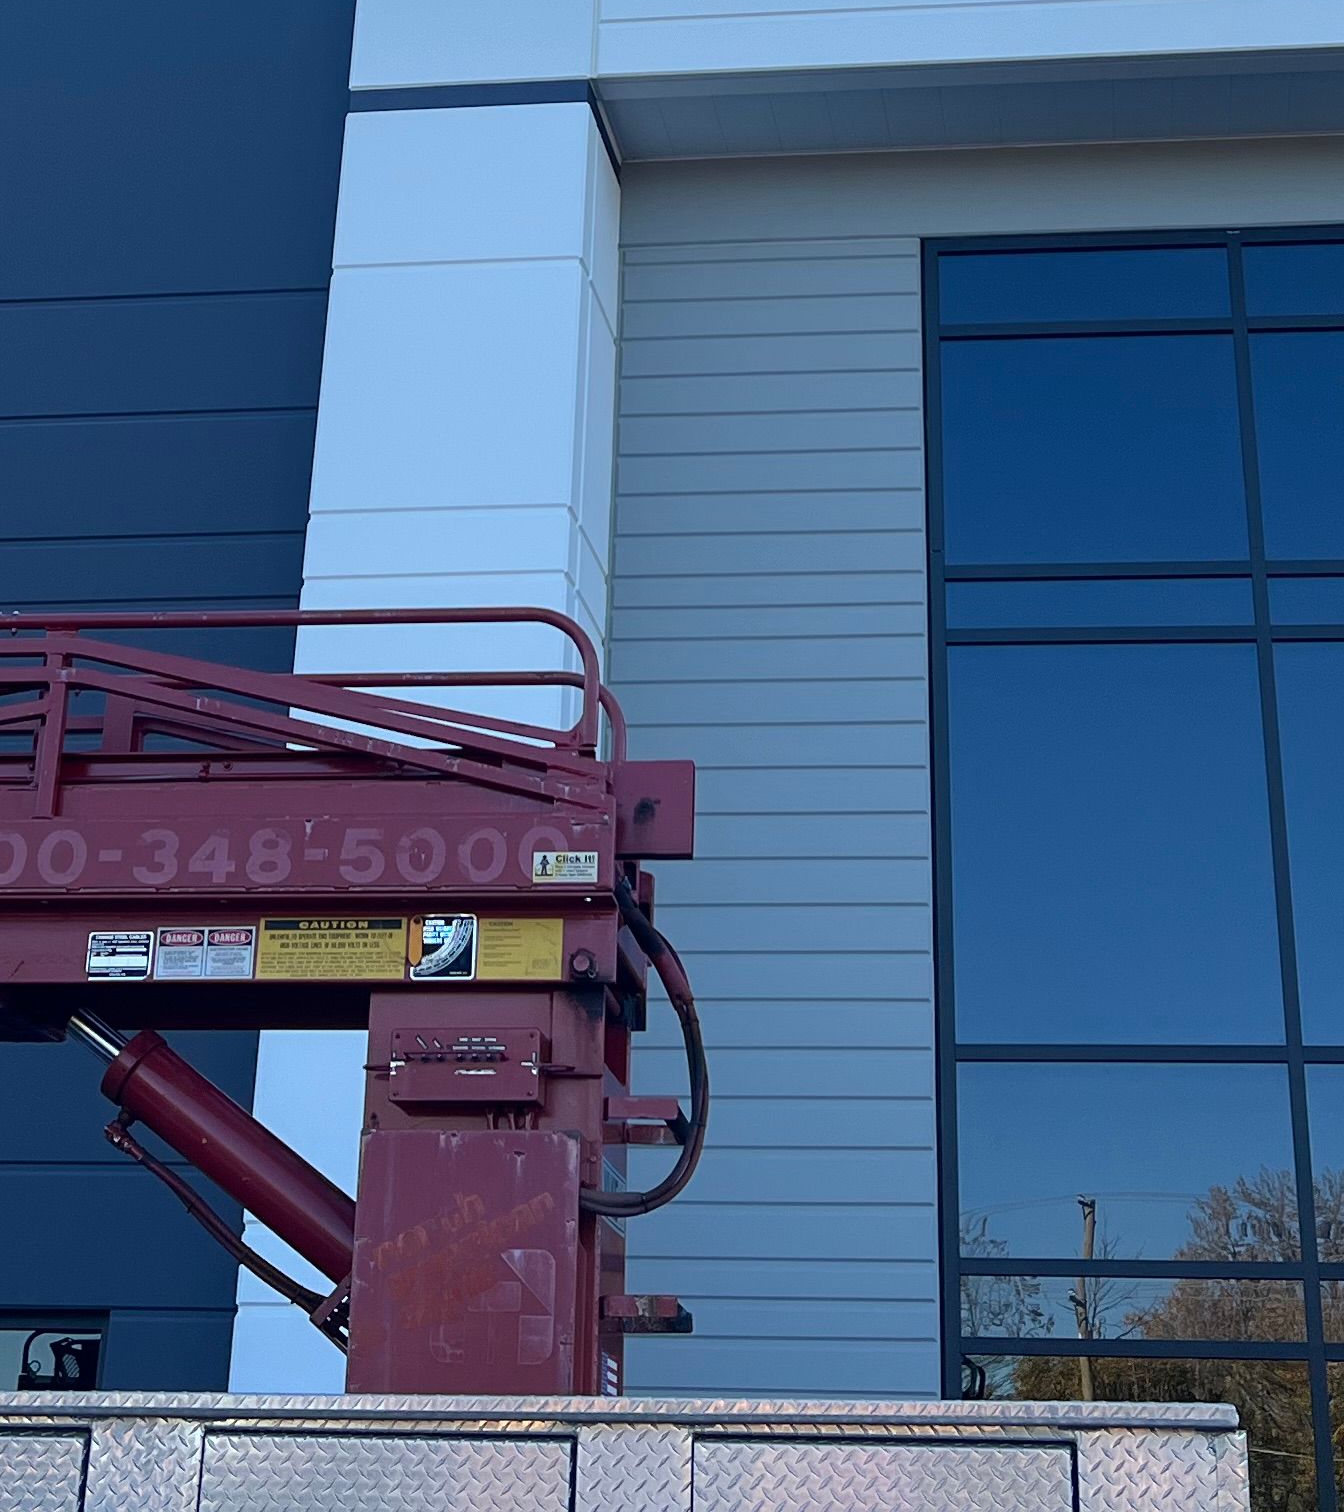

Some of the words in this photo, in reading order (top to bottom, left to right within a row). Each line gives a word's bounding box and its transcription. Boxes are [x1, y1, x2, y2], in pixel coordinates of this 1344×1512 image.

[555, 854, 581, 864] Click
[298, 920, 369, 930] CAUTION
[165, 933, 198, 944] DANGER
[214, 932, 246, 943] DANGER
